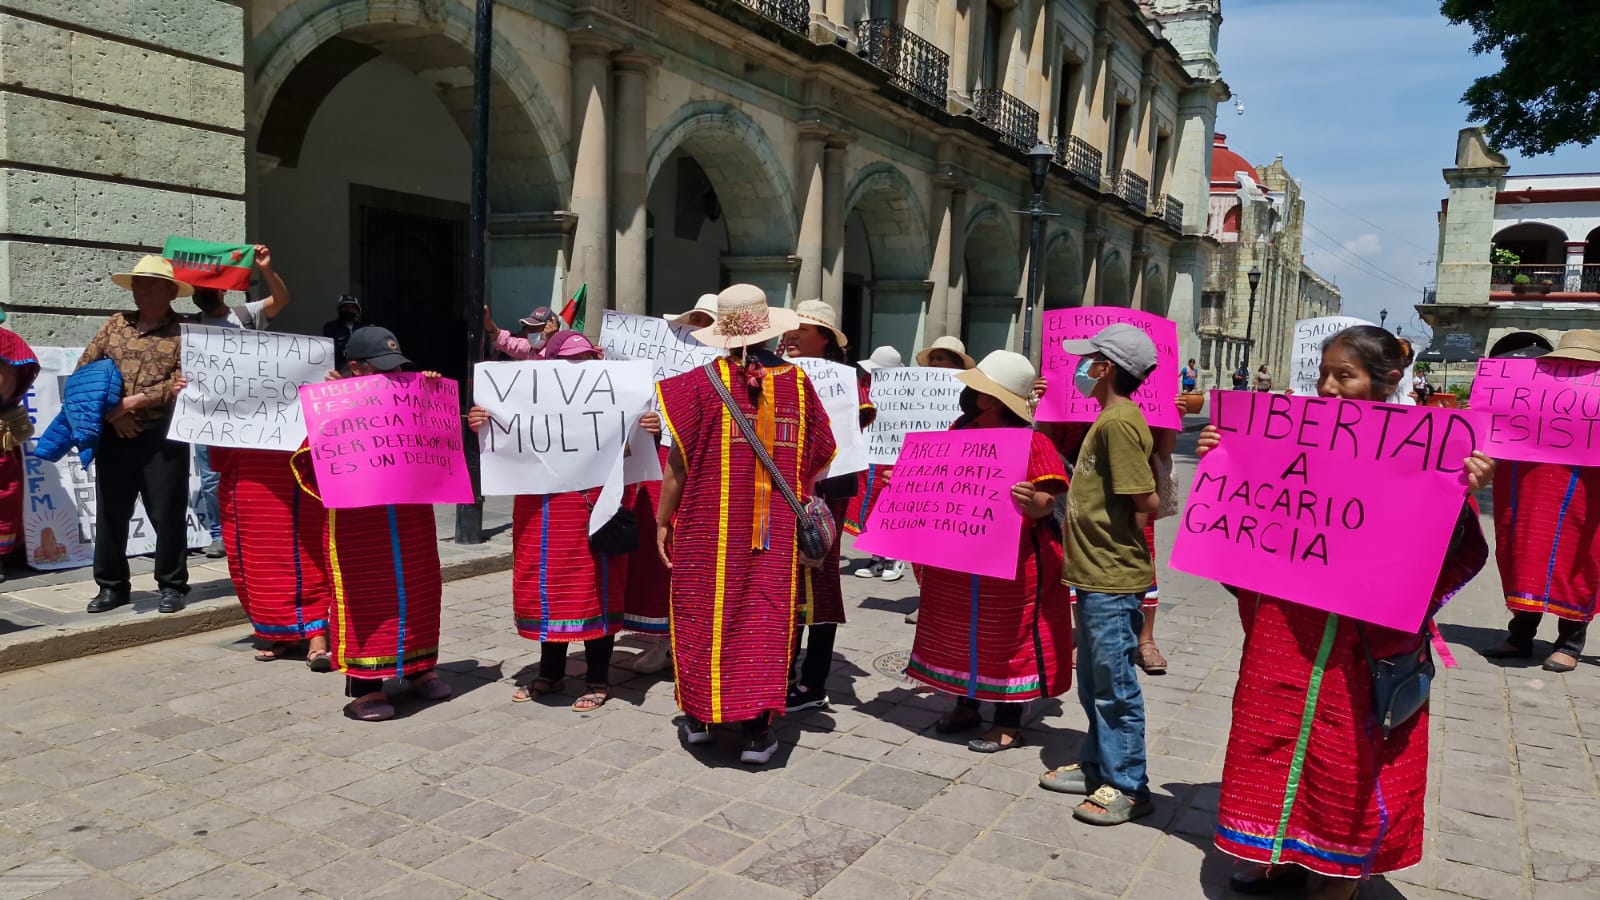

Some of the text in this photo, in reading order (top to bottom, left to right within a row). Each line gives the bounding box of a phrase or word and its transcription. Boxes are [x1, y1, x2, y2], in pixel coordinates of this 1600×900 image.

[1049, 315, 1067, 331] EL
[185, 325, 327, 365] LIBERTAD
[186, 350, 286, 379] PARA EL
[874, 371, 890, 382] NO
[1478, 360, 1511, 379] EL
[184, 371, 313, 400] PROFESO
[308, 376, 410, 401] LIBERTAD
[483, 367, 616, 406] VIVA
[393, 393, 458, 417] MACARIO
[176, 418, 282, 445] GARCIA
[370, 433, 441, 449] DEFENSOR
[447, 436, 461, 451] NO
[487, 410, 626, 454] MULTI
[1216, 391, 1477, 474] LIBERTAD
[900, 441, 998, 461] CARCEL PARA
[330, 461, 358, 475] ES
[370, 453, 396, 468] UN
[893, 464, 1007, 480] ELEAZAR ORTIZ
[1280, 452, 1309, 485] A
[895, 481, 945, 494] EMELIA
[950, 481, 1001, 502] ORTIZ
[1194, 471, 1366, 530] MACARIO
[945, 502, 967, 516] DE
[971, 506, 995, 521] LA
[933, 518, 987, 537] TRIQUI
[1185, 503, 1329, 566] GARCIA
